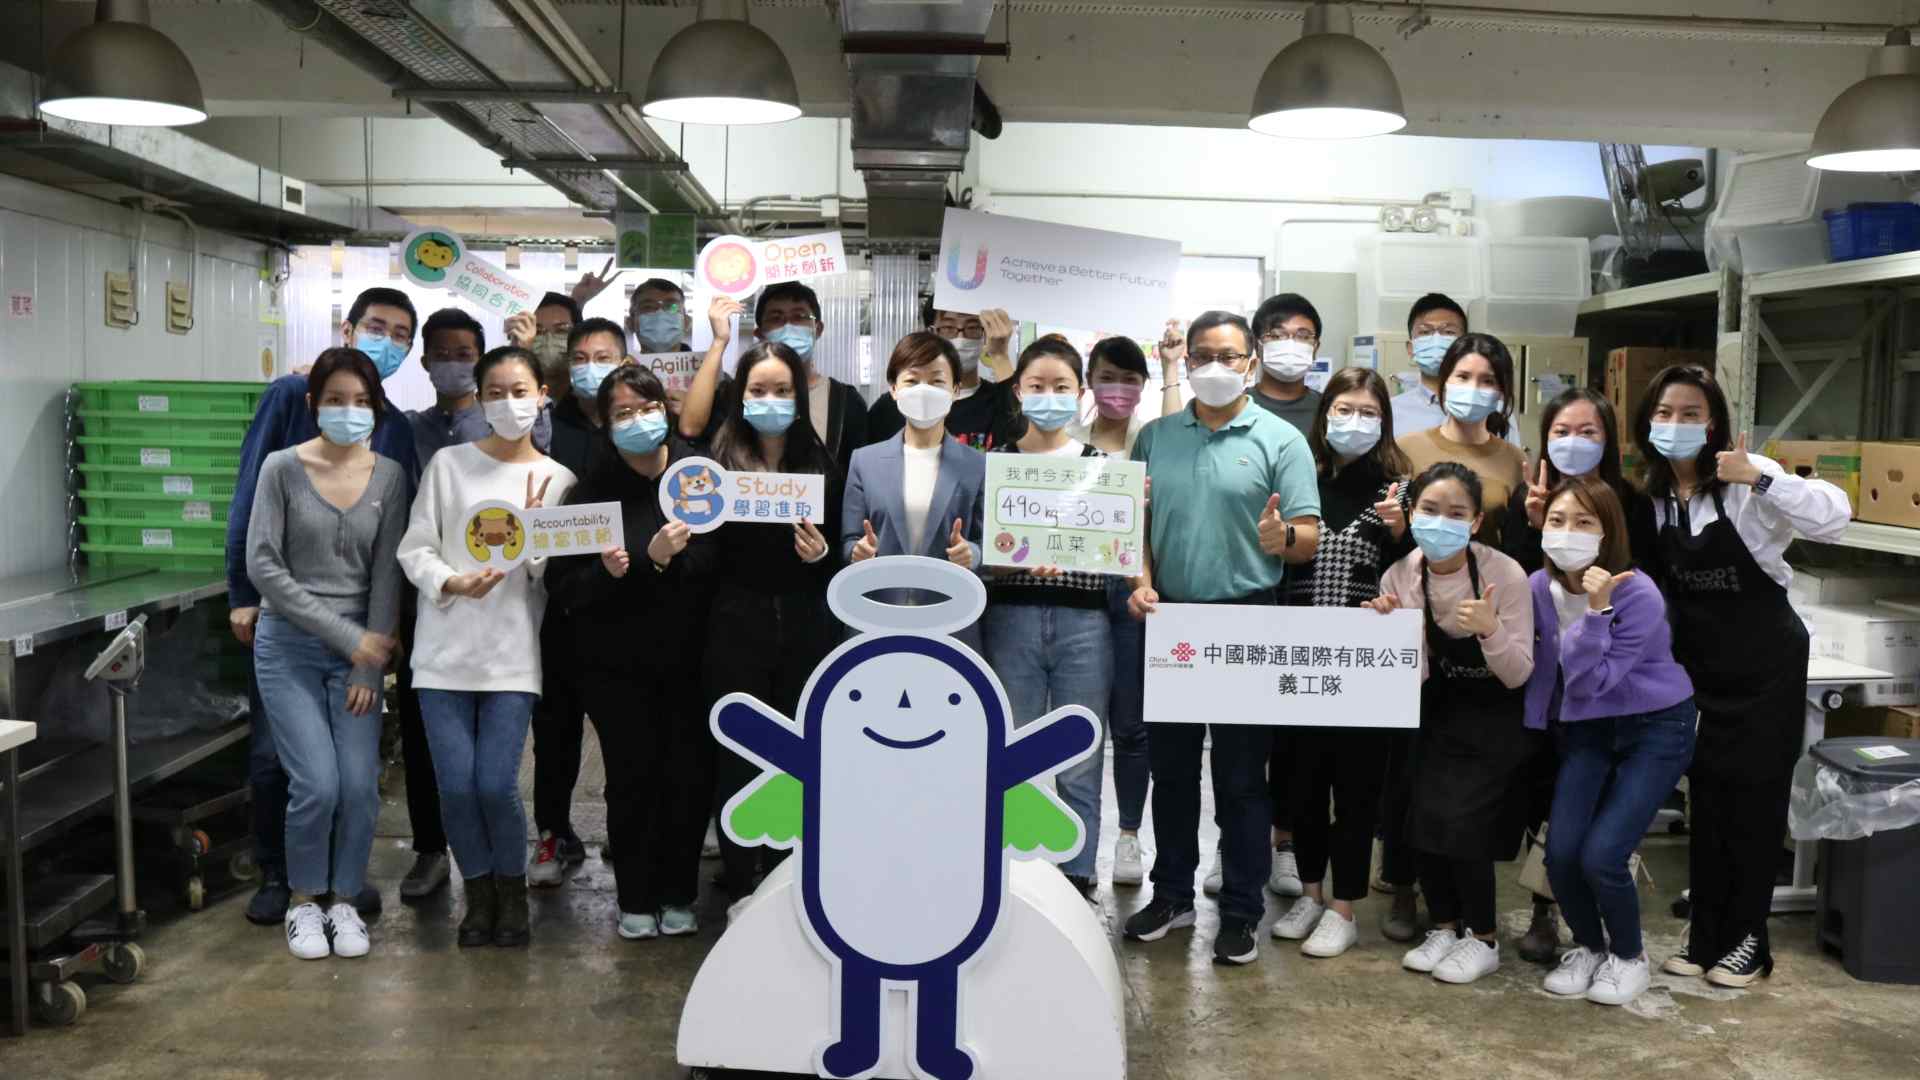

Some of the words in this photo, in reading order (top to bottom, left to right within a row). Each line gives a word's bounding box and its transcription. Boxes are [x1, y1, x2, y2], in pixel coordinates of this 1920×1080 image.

[765, 242, 827, 262] Open
[465, 261, 530, 298] Collaboration
[1000, 255, 1058, 273] Achieve
[1059, 264, 1067, 274] a
[1069, 263, 1116, 281] Better
[1120, 272, 1168, 288] Future
[1000, 269, 1063, 287] Together
[651, 356, 703, 374] Agilit
[736, 476, 807, 498] Study
[1006, 466, 1128, 488] 我們今天理了
[733, 499, 812, 518] 學習進取
[1001, 494, 1041, 518] 490
[1075, 500, 1105, 526] 30
[533, 513, 610, 529] Accountability
[1046, 534, 1086, 552] 瓜菜
[1204, 643, 1419, 668] 中國聯通國際有限公司
[1278, 673, 1343, 696] 義工隊
